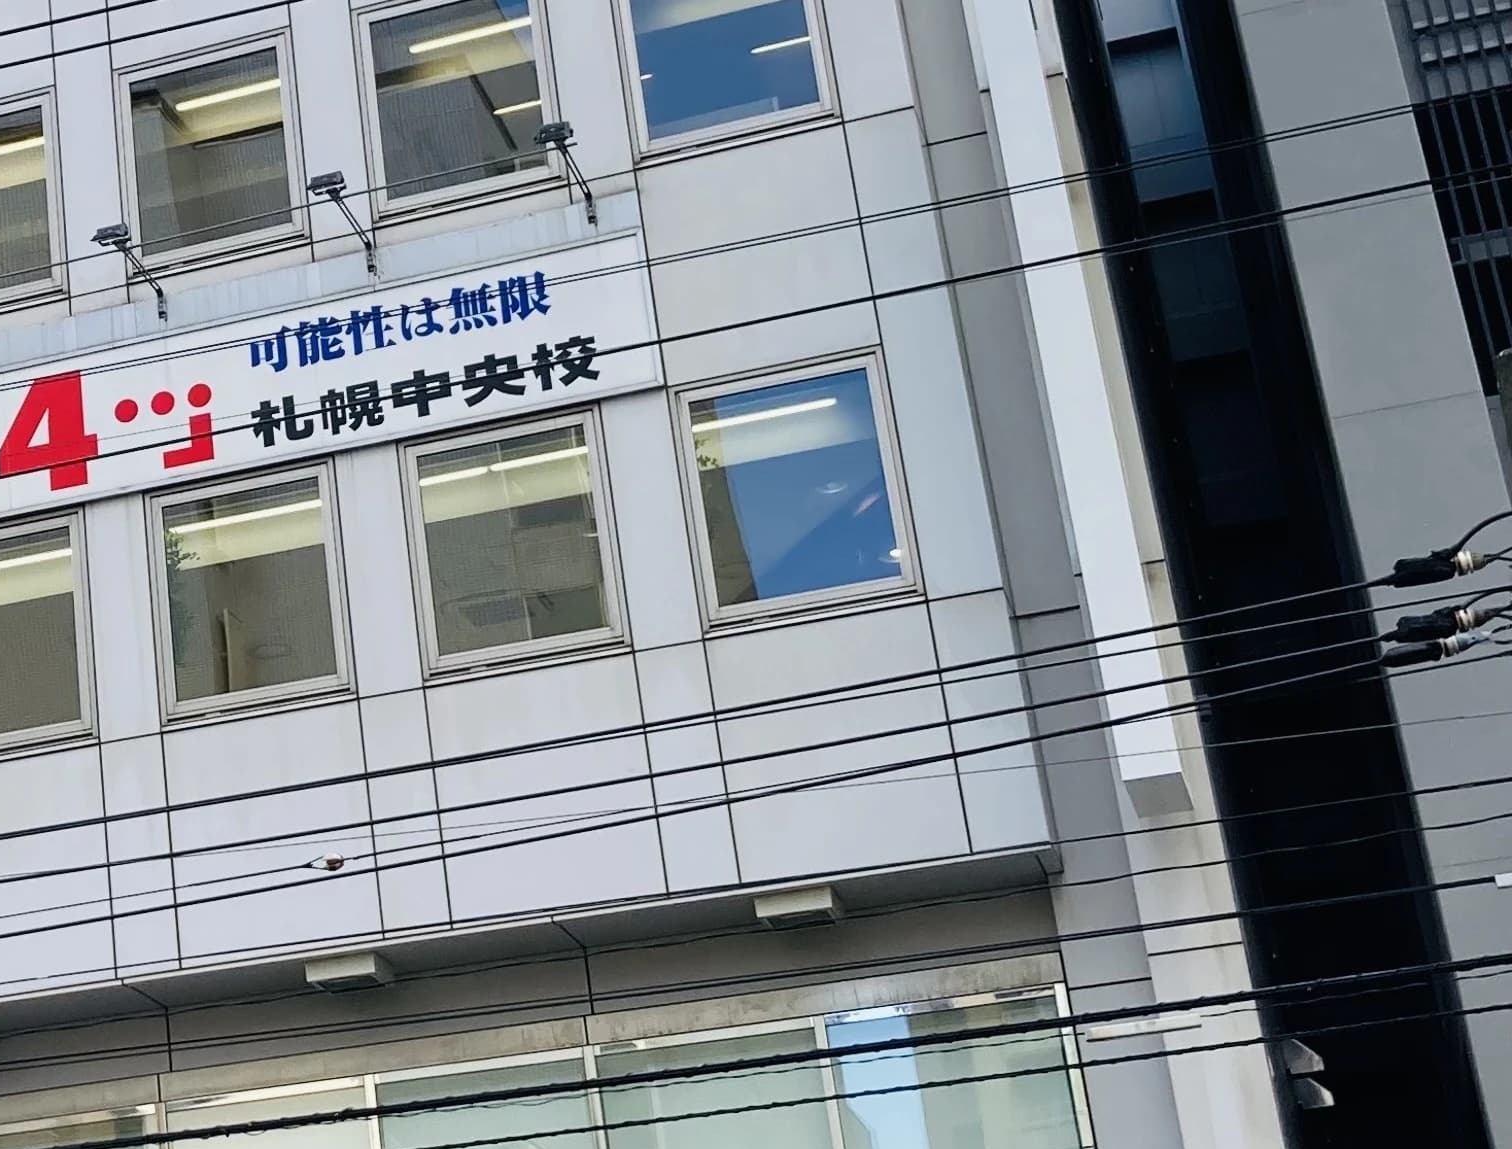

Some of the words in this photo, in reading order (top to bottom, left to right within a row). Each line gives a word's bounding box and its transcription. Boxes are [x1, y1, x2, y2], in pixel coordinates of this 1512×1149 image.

[249, 270, 553, 372] 可能性は無限
[251, 334, 602, 447] 札幌中央校
